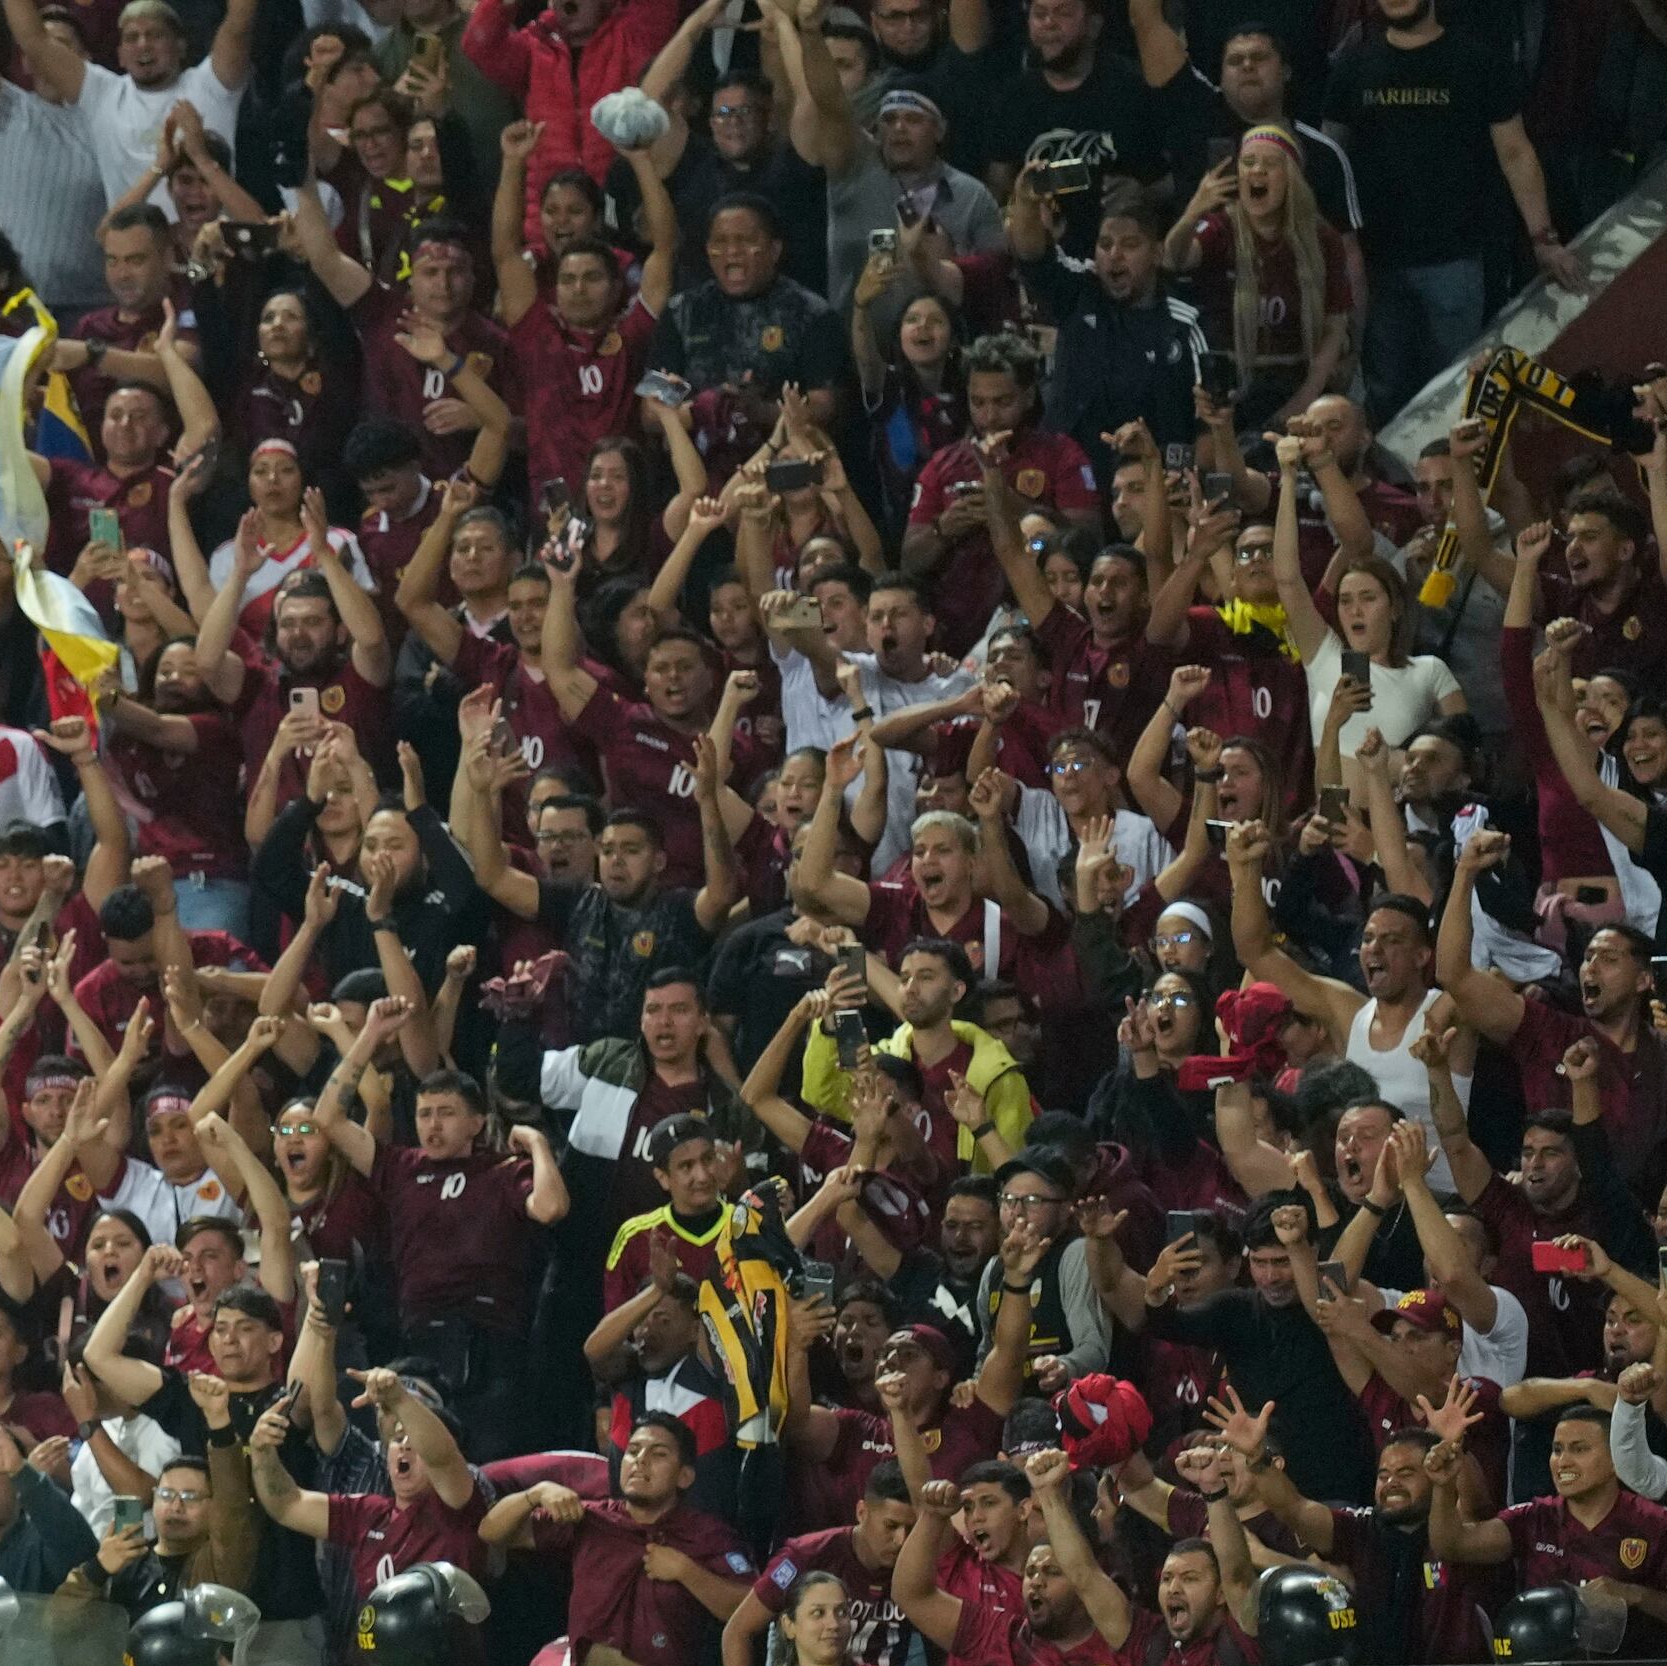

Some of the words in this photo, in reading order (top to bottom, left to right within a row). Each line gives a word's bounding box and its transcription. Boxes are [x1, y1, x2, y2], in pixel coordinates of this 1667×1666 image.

[1361, 87, 1451, 107] BARBERS
[579, 365, 604, 398] 10
[667, 763, 697, 798] 10
[440, 1171, 468, 1201] 10
[1326, 1610, 1358, 1631] USE
